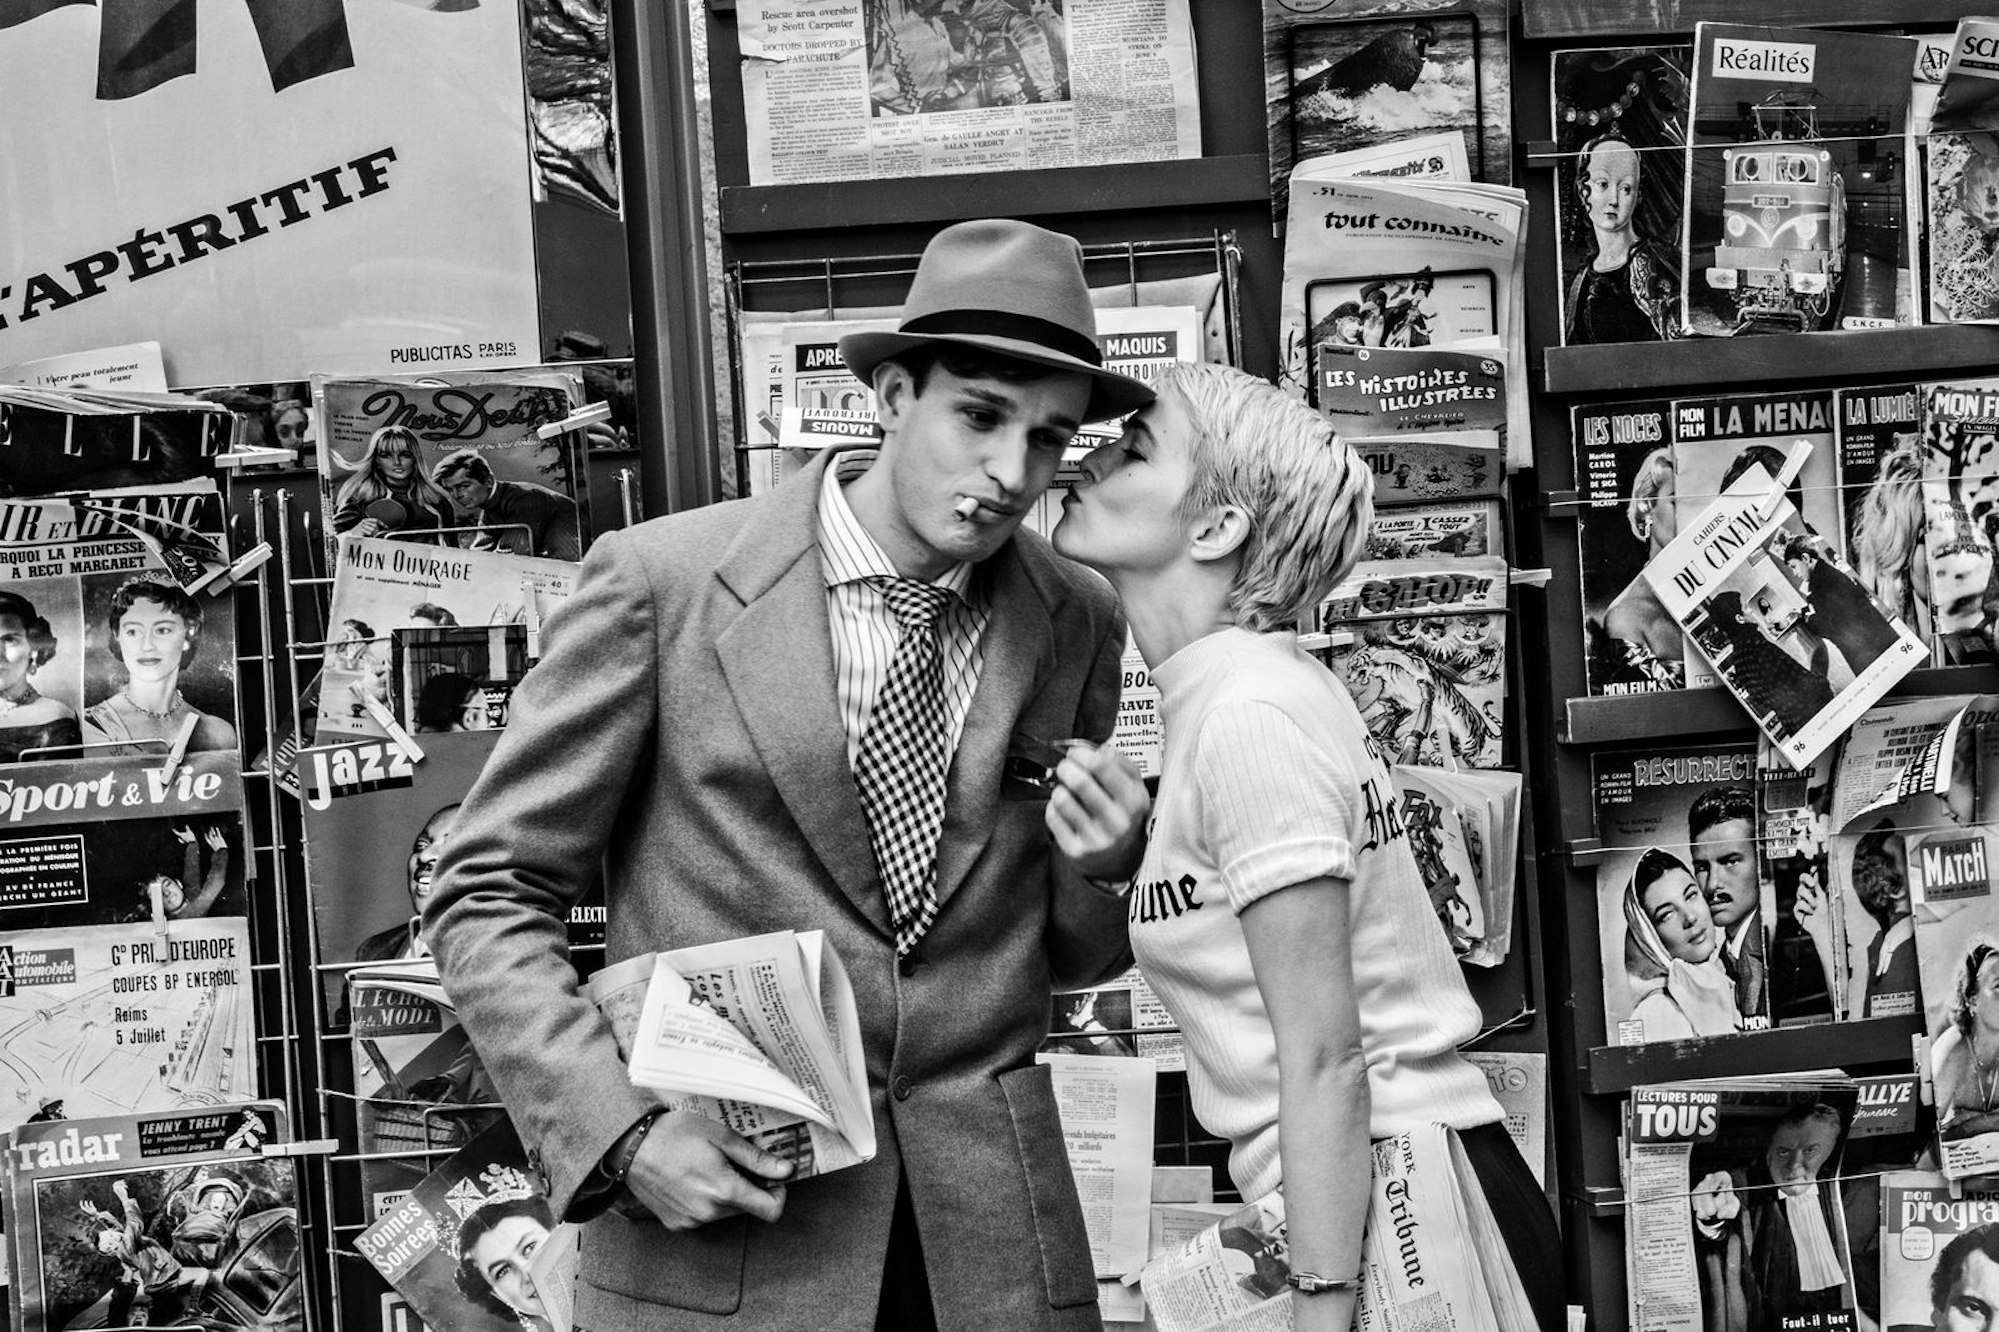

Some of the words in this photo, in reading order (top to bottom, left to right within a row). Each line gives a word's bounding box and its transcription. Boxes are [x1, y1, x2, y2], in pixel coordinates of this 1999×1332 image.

[761, 10, 792, 20] Rescue
[796, 10, 815, 18] area
[820, 6, 858, 16] overshot
[767, 24, 778, 33] by
[782, 22, 805, 31] Scott
[809, 20, 854, 30] Carpenter
[1719, 46, 1810, 75] Réalités
[1324, 211, 1380, 229] tout
[1385, 216, 1504, 246] connaître
[391, 344, 473, 363] PUBLICITAS
[479, 341, 517, 352] PARIS
[1107, 336, 1168, 357] MAQUIS
[93, 363, 138, 376] totalement
[1325, 370, 1357, 388] LES
[362, 389, 458, 433] Nous
[1846, 397, 1867, 426] LA
[1934, 392, 1980, 417] MON
[1679, 408, 1705, 423] MON
[1713, 406, 1744, 436] LA
[811, 420, 874, 436] MAQUIS
[1584, 416, 1610, 446] LES
[1612, 413, 1662, 444] NOCES
[1679, 422, 1706, 439] FILM
[1589, 461, 1617, 469] CAROL
[1601, 479, 1617, 488] SICA
[49, 521, 77, 540] ET
[1693, 511, 1728, 548] CAHIERS
[48, 547, 67, 561] LA
[73, 541, 146, 559] PRINCESSE
[12, 567, 22, 579] A
[70, 556, 146, 573] MARGARET
[1672, 561, 1707, 599] DU
[1603, 683, 1628, 696] MON
[1630, 680, 1657, 694] FILM
[1116, 729, 1158, 738] nouvelles
[121, 782, 145, 806] &
[142, 765, 222, 804] Vie
[1922, 841, 1987, 888] MATCH
[37, 880, 74, 889] FRANCE
[113, 974, 157, 994] COUPES
[165, 973, 180, 991] BP
[187, 969, 238, 989] ENERGOL
[115, 1006, 148, 1023] Reims
[380, 1008, 436, 1027] MODE
[116, 1030, 123, 1045] 5
[130, 1028, 166, 1045] Juillet
[1638, 1091, 1687, 1104] LECTURES
[1690, 1093, 1718, 1104] POUR
[141, 1120, 182, 1136] JENNY
[188, 1115, 229, 1131] TRENT
[1637, 1104, 1717, 1137] TOUS
[18, 1128, 123, 1171] radar
[1903, 1191, 1932, 1202] mon
[356, 1202, 423, 1258] Bonnes
[1385, 1178, 1425, 1290] Tribune
[375, 1218, 437, 1275] Soirées
